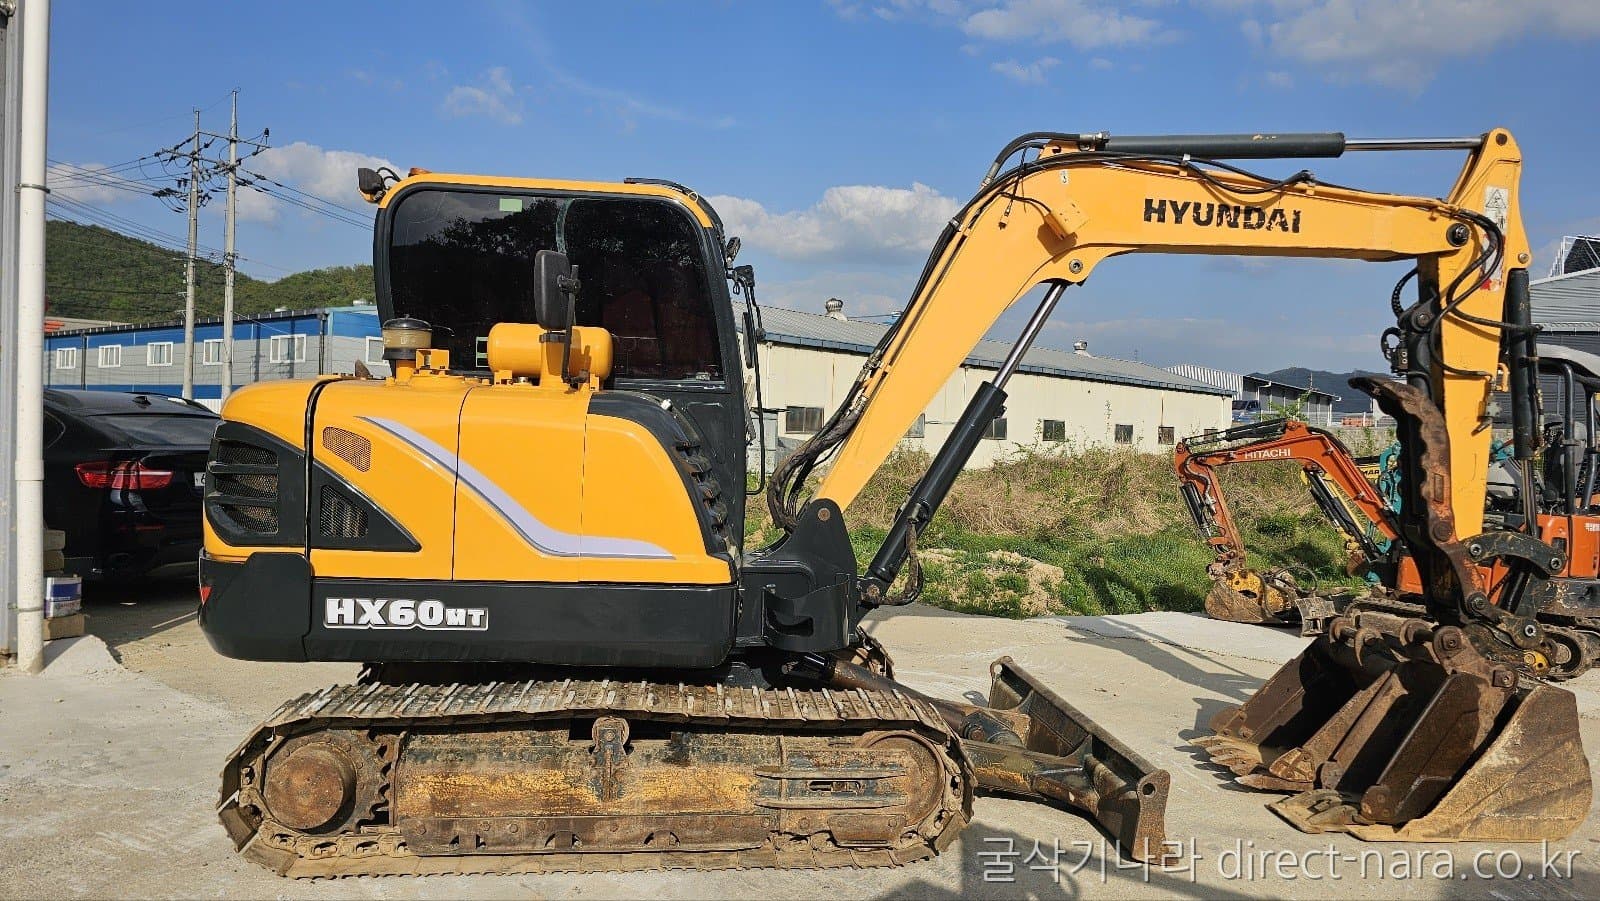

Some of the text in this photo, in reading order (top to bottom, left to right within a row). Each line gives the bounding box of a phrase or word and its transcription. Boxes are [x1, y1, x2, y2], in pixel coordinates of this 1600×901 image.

[1144, 198, 1301, 233] HYUNDAI
[1244, 447, 1291, 460] HITACHI
[325, 598, 486, 627] HX60MT
